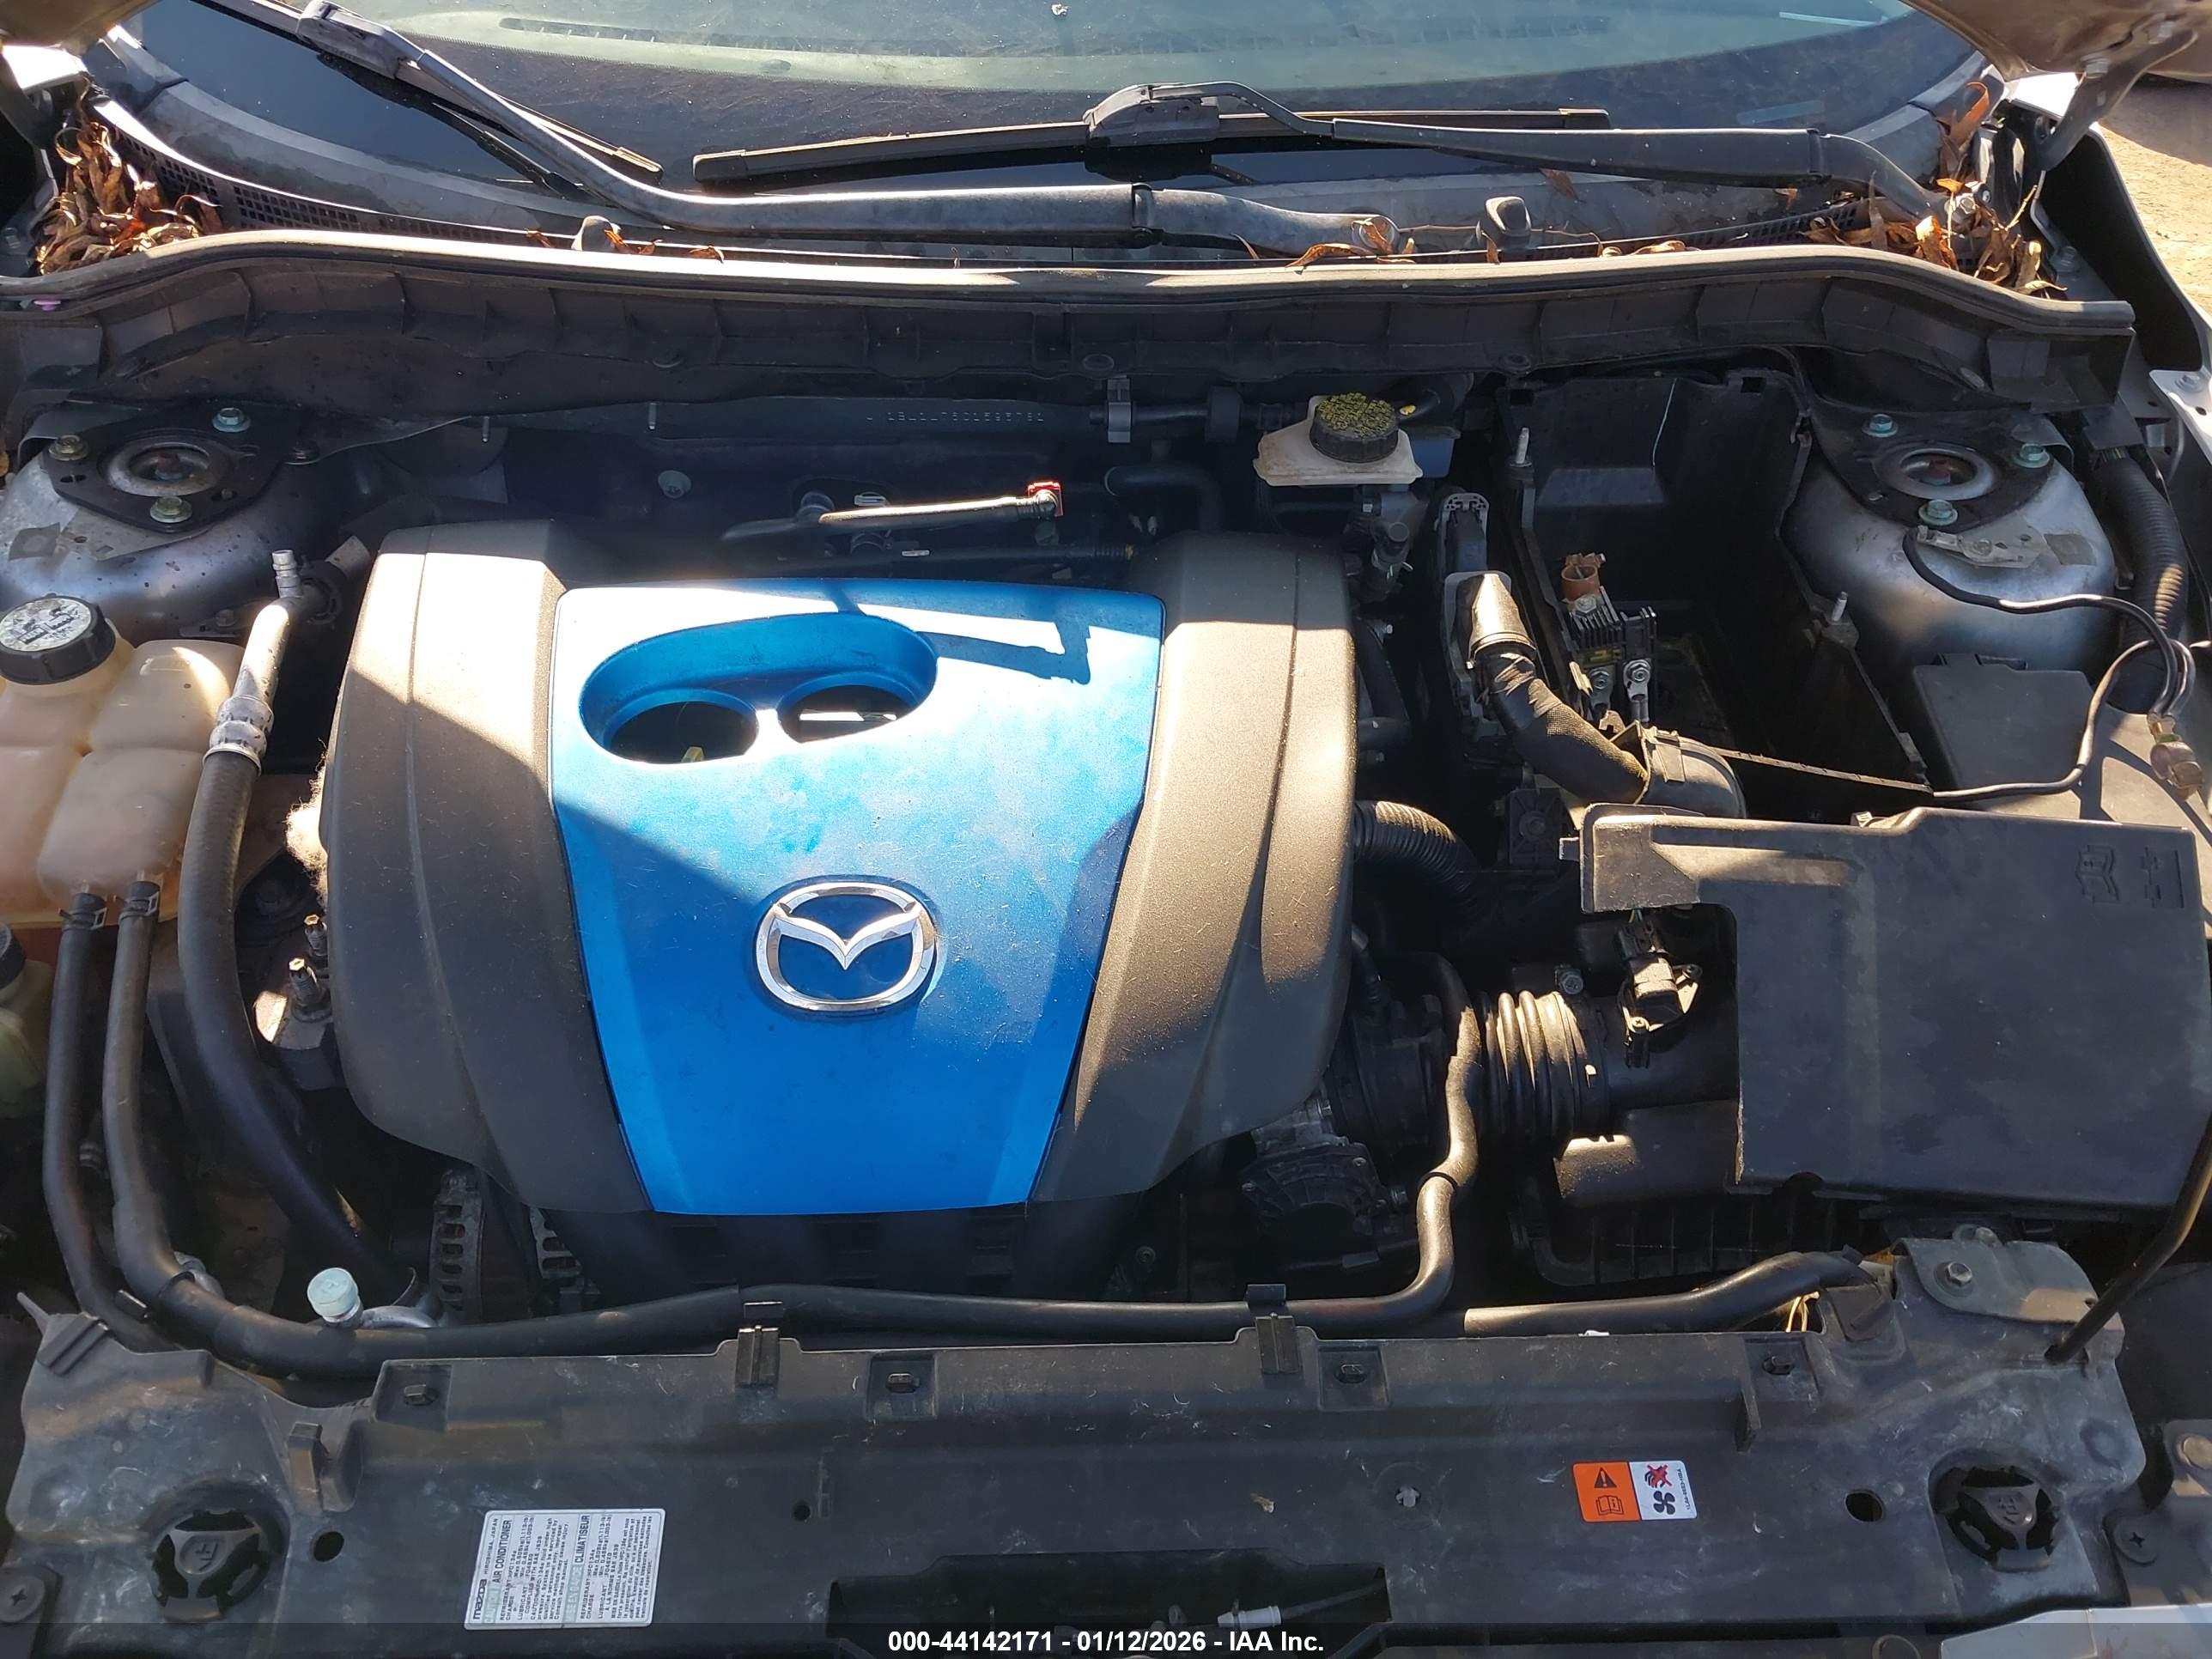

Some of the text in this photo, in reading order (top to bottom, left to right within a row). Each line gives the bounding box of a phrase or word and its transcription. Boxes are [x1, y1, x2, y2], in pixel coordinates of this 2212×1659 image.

[494, 1520, 511, 1568] CONDITIONER
[573, 1515, 590, 1563] CLIMATISEUR
[472, 1578, 487, 1620] mazda
[491, 1571, 502, 1583] AIR
